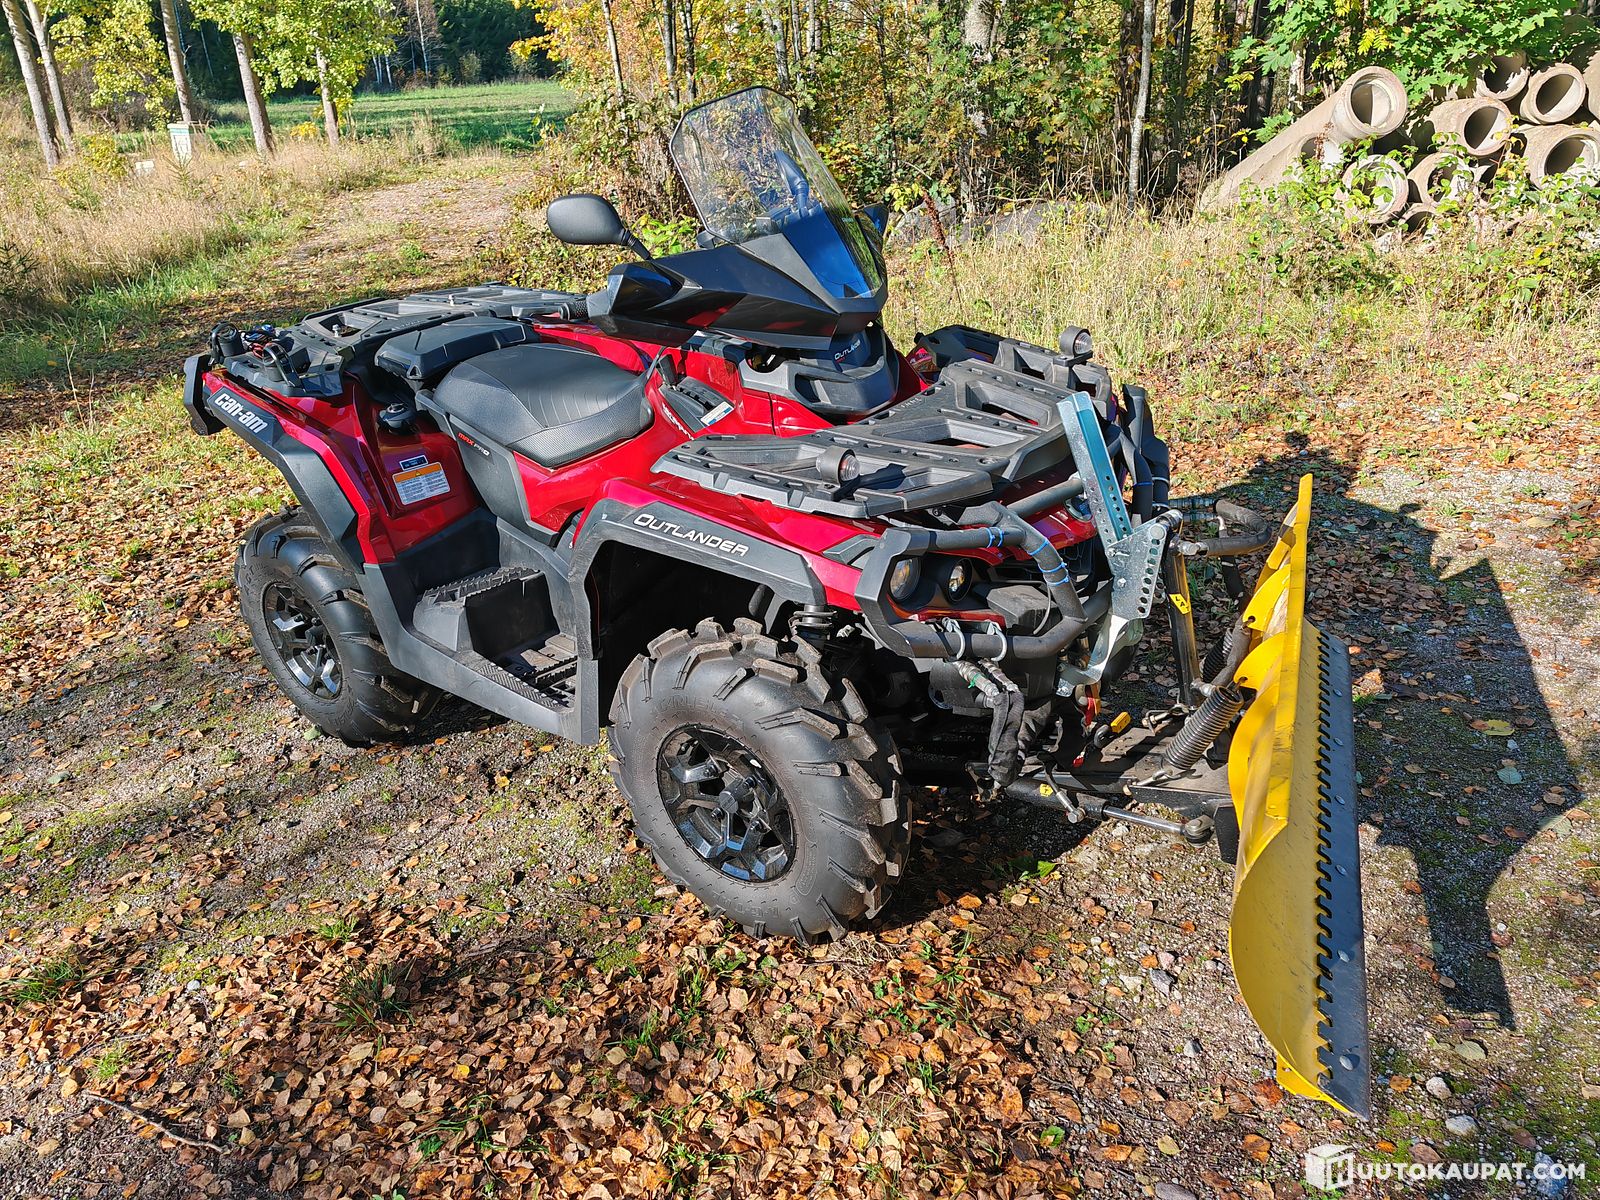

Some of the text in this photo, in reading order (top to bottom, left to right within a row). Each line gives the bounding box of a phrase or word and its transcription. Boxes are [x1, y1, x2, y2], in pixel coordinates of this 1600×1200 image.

[214, 393, 268, 433] can-am
[458, 432, 475, 446] MAX
[633, 513, 749, 557] OUTLANDER
